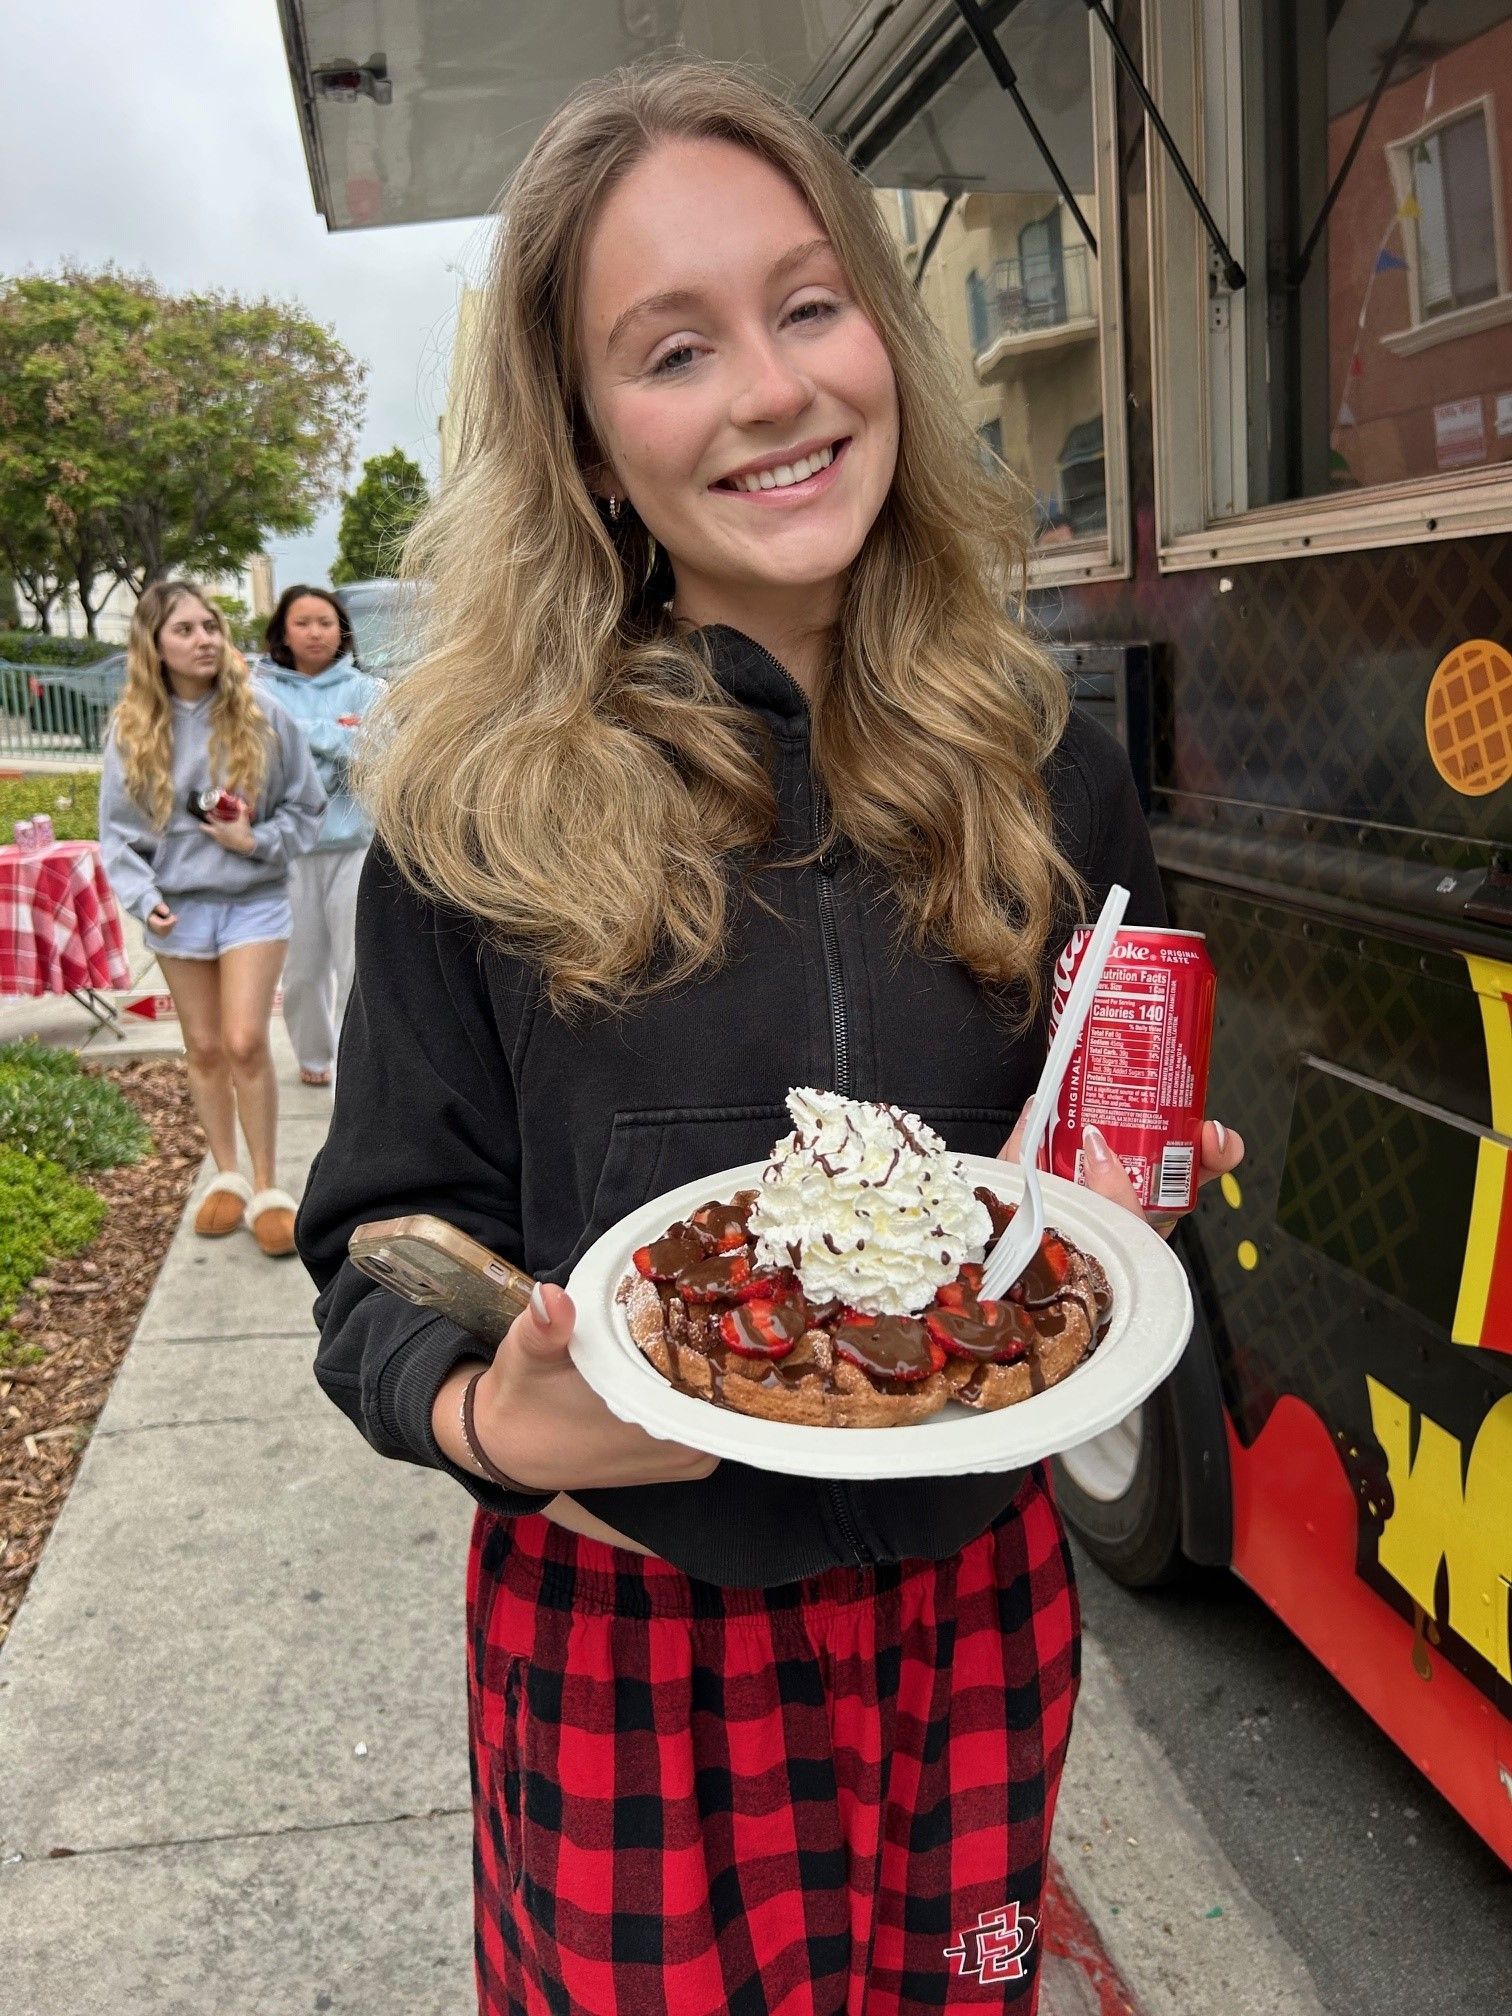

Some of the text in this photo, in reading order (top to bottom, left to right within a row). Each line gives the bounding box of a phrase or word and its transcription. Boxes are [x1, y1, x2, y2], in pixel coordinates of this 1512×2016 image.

[1160, 949, 1199, 959] ORIGINAL
[1162, 956, 1190, 964] TASTE
[1100, 969, 1167, 984] utrition Facts
[1097, 983, 1109, 991] erv.
[1110, 983, 1122, 991] Size
[1154, 986, 1165, 994] Can
[1093, 1004, 1163, 1021] Calories 140
[1102, 1057, 1118, 1065] Sugars
[1128, 1069, 1144, 1077] Sugars
[1068, 1056, 1081, 1129] ORIGINAL
